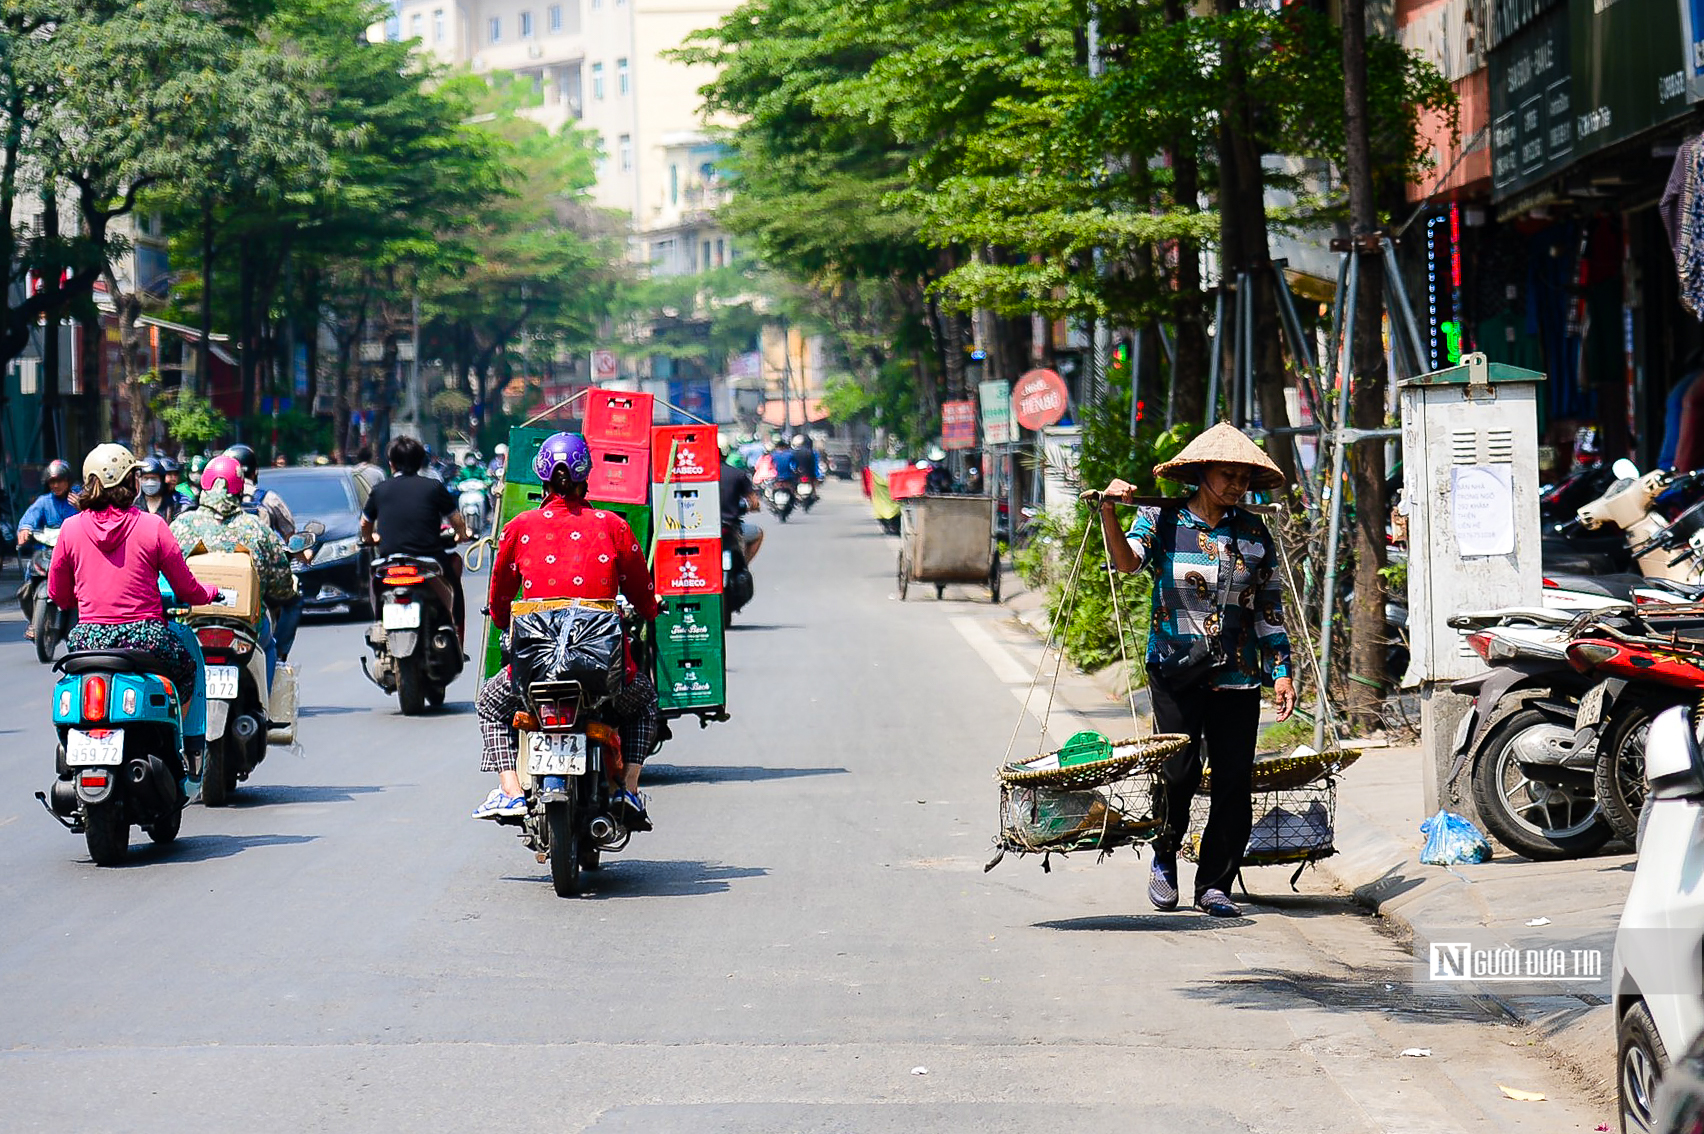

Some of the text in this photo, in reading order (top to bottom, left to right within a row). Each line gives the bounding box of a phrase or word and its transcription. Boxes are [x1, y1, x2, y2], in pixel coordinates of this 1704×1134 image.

[671, 579, 706, 588] HABECO
[205, 668, 230, 682] 9-T1
[71, 747, 118, 762] 959.72
